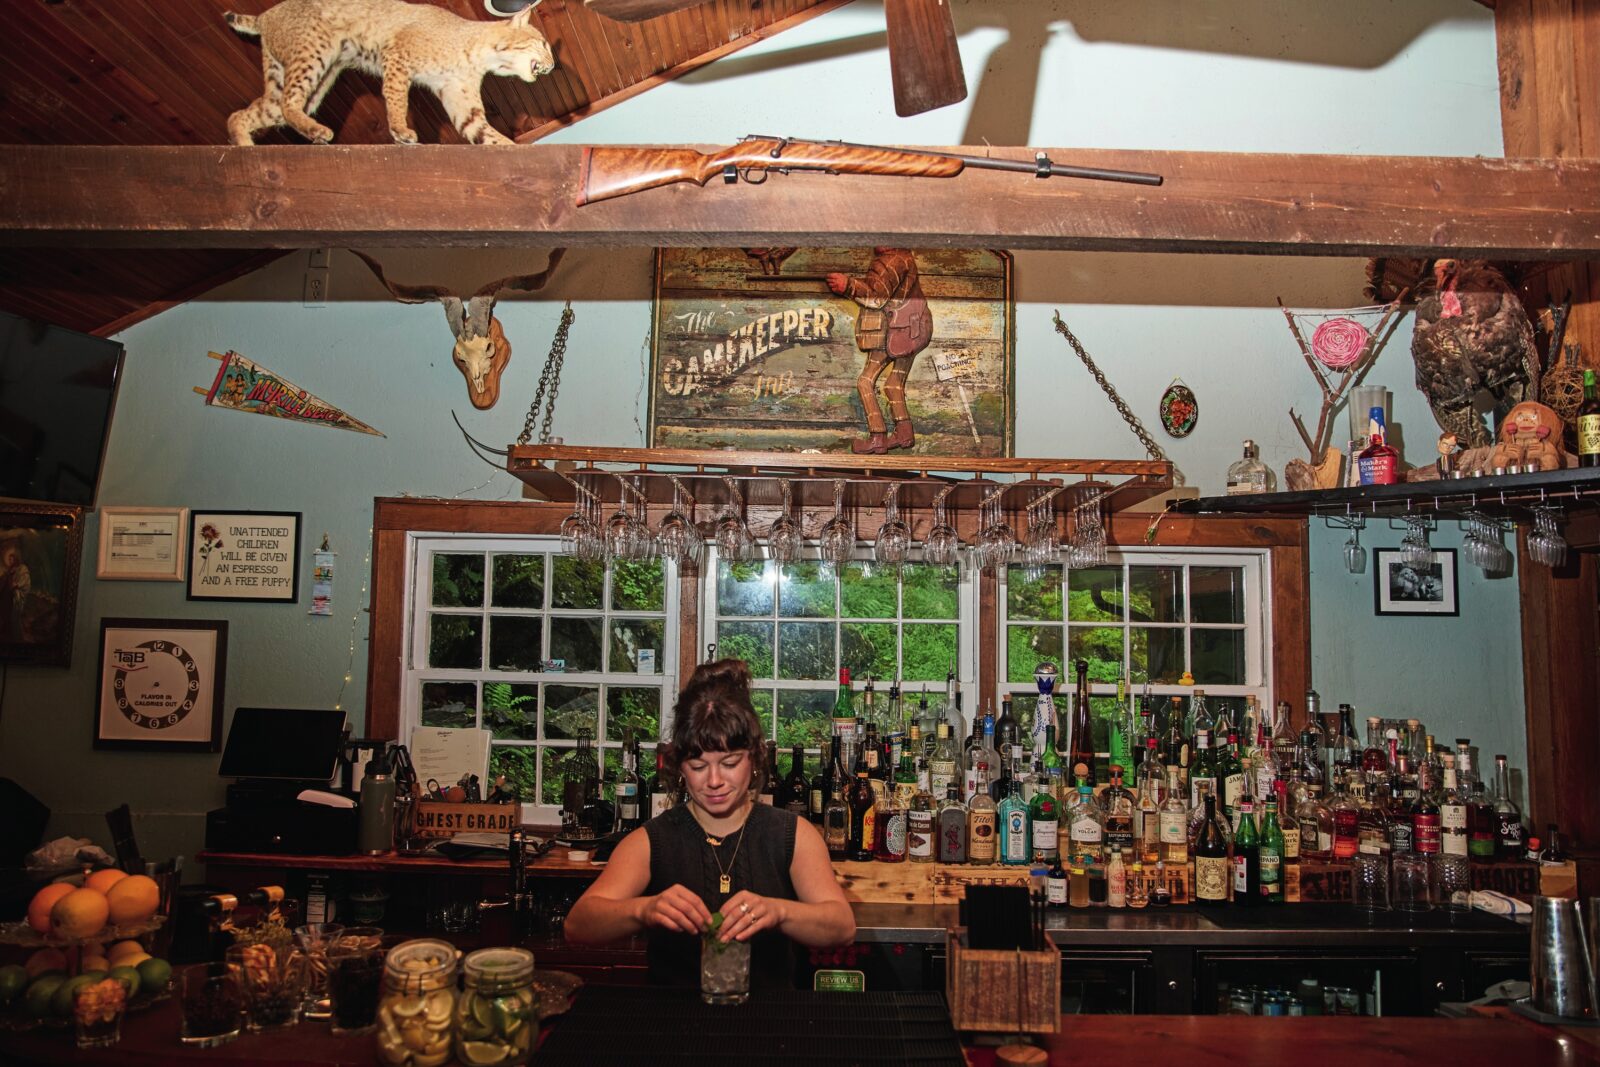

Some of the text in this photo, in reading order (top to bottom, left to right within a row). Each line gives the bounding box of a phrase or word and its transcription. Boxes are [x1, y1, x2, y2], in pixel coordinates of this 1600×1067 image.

[674, 311, 717, 334] The
[247, 378, 344, 422] MYRTLE BEACH
[229, 526, 289, 537] UNATTENDED
[236, 539, 279, 549] CHILDREN
[220, 551, 288, 562] WILL BE GIVEN
[215, 563, 279, 574] AN ESPRESSO
[201, 576, 291, 587] AND A FREE PUPPY
[154, 641, 164, 650] 12
[186, 662, 194, 671] 2
[116, 680, 123, 689] 9
[191, 681, 198, 690] 3
[119, 699, 127, 709] 8
[184, 700, 191, 710] 4
[132, 713, 140, 722] 7
[150, 717, 158, 727] 6
[169, 714, 177, 724] 5
[467, 813, 514, 830] GRADE
[820, 976, 847, 984] REVIEW
